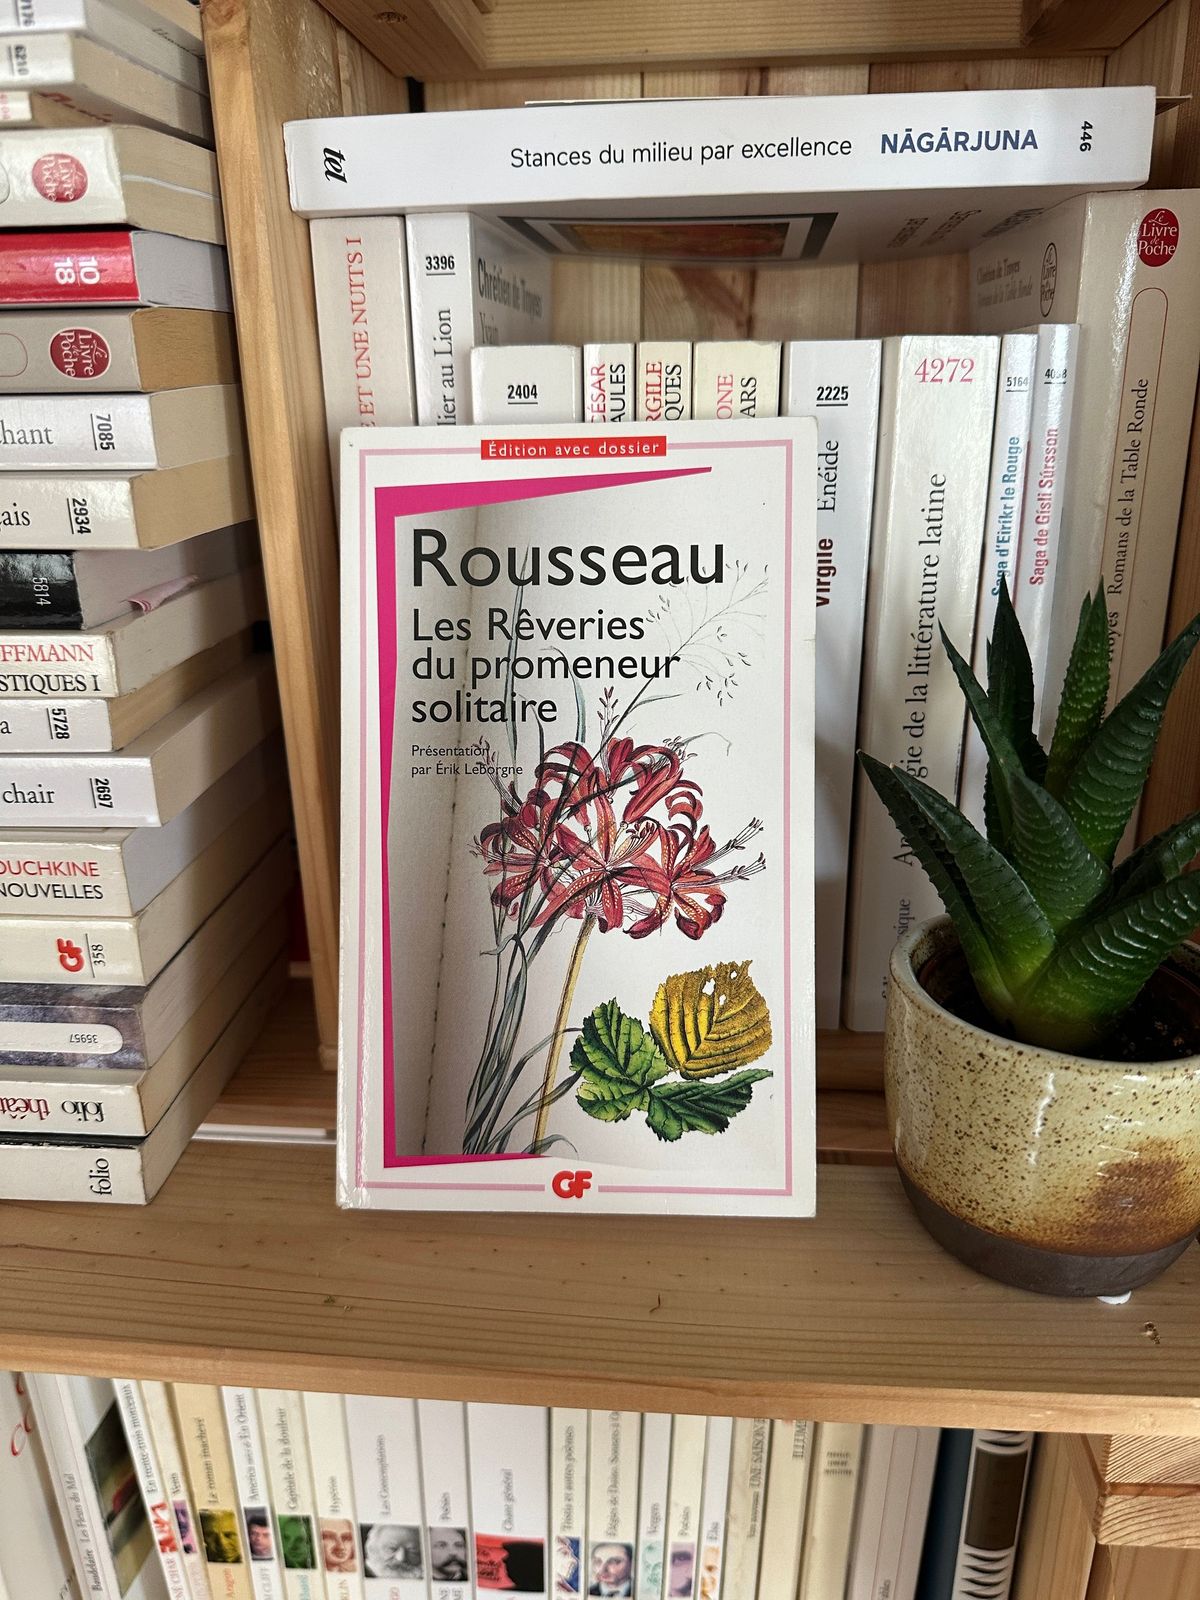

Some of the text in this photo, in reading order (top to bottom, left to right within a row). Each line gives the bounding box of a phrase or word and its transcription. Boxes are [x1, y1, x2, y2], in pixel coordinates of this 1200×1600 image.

[510, 126, 1038, 168] Stances du milieu par excellence NĀGĀRJUNA
[1079, 120, 1093, 152] 446
[323, 147, 347, 183] tel
[1142, 223, 1178, 237] Livre
[1148, 210, 1169, 226] Le
[346, 237, 362, 245] I
[1138, 241, 1176, 255] Poche
[54, 257, 76, 285] 18
[79, 257, 100, 285] 10
[425, 255, 455, 271] 3396
[347, 251, 368, 326] NUITS
[433, 308, 453, 357] Lion
[60, 331, 77, 377] Poche
[78, 334, 95, 376] Livre
[353, 330, 372, 380] UNE
[442, 364, 455, 388] au
[914, 358, 975, 384] 4272
[1006, 376, 1029, 388] 5164
[358, 386, 375, 416] ET
[507, 384, 538, 400] 2404
[716, 374, 734, 420] ONE
[816, 386, 849, 401] 2225
[1127, 378, 1149, 434] Ronde
[0, 420, 54, 445] hant
[95, 414, 115, 450] 7085
[488, 441, 660, 457] Édition avec dossier
[1002, 436, 1022, 484] Rouge
[1120, 438, 1141, 485] Table
[816, 440, 840, 513] Énéide
[1000, 486, 1016, 501] le
[1117, 488, 1135, 503] la
[72, 498, 91, 534] 2934
[918, 473, 947, 546] latine
[1115, 506, 1132, 527] de
[1033, 528, 1049, 547] de
[413, 528, 724, 587] Rousseau
[1030, 552, 1048, 585] Saga
[1107, 531, 1130, 596] Romans
[32, 577, 51, 606] 5814
[413, 607, 645, 641] Les Rêveries
[907, 553, 940, 678] littérature
[0, 645, 94, 662] FFMANN
[412, 647, 682, 690] du promeneur
[92, 675, 101, 692] I
[905, 683, 929, 705] la
[411, 690, 557, 723] solitaire
[52, 708, 70, 740] 5728
[903, 711, 926, 739] de
[411, 745, 490, 757] Présentation
[411, 760, 523, 778] par Érik Leborgne
[3, 783, 55, 804] chair
[95, 778, 113, 808] 2697
[57, 938, 85, 973] GF
[91, 943, 105, 966] 358
[69, 1033, 98, 1044] 35957
[62, 1100, 105, 1122] folio
[89, 1158, 112, 1196] folio
[552, 1170, 593, 1199] GF
